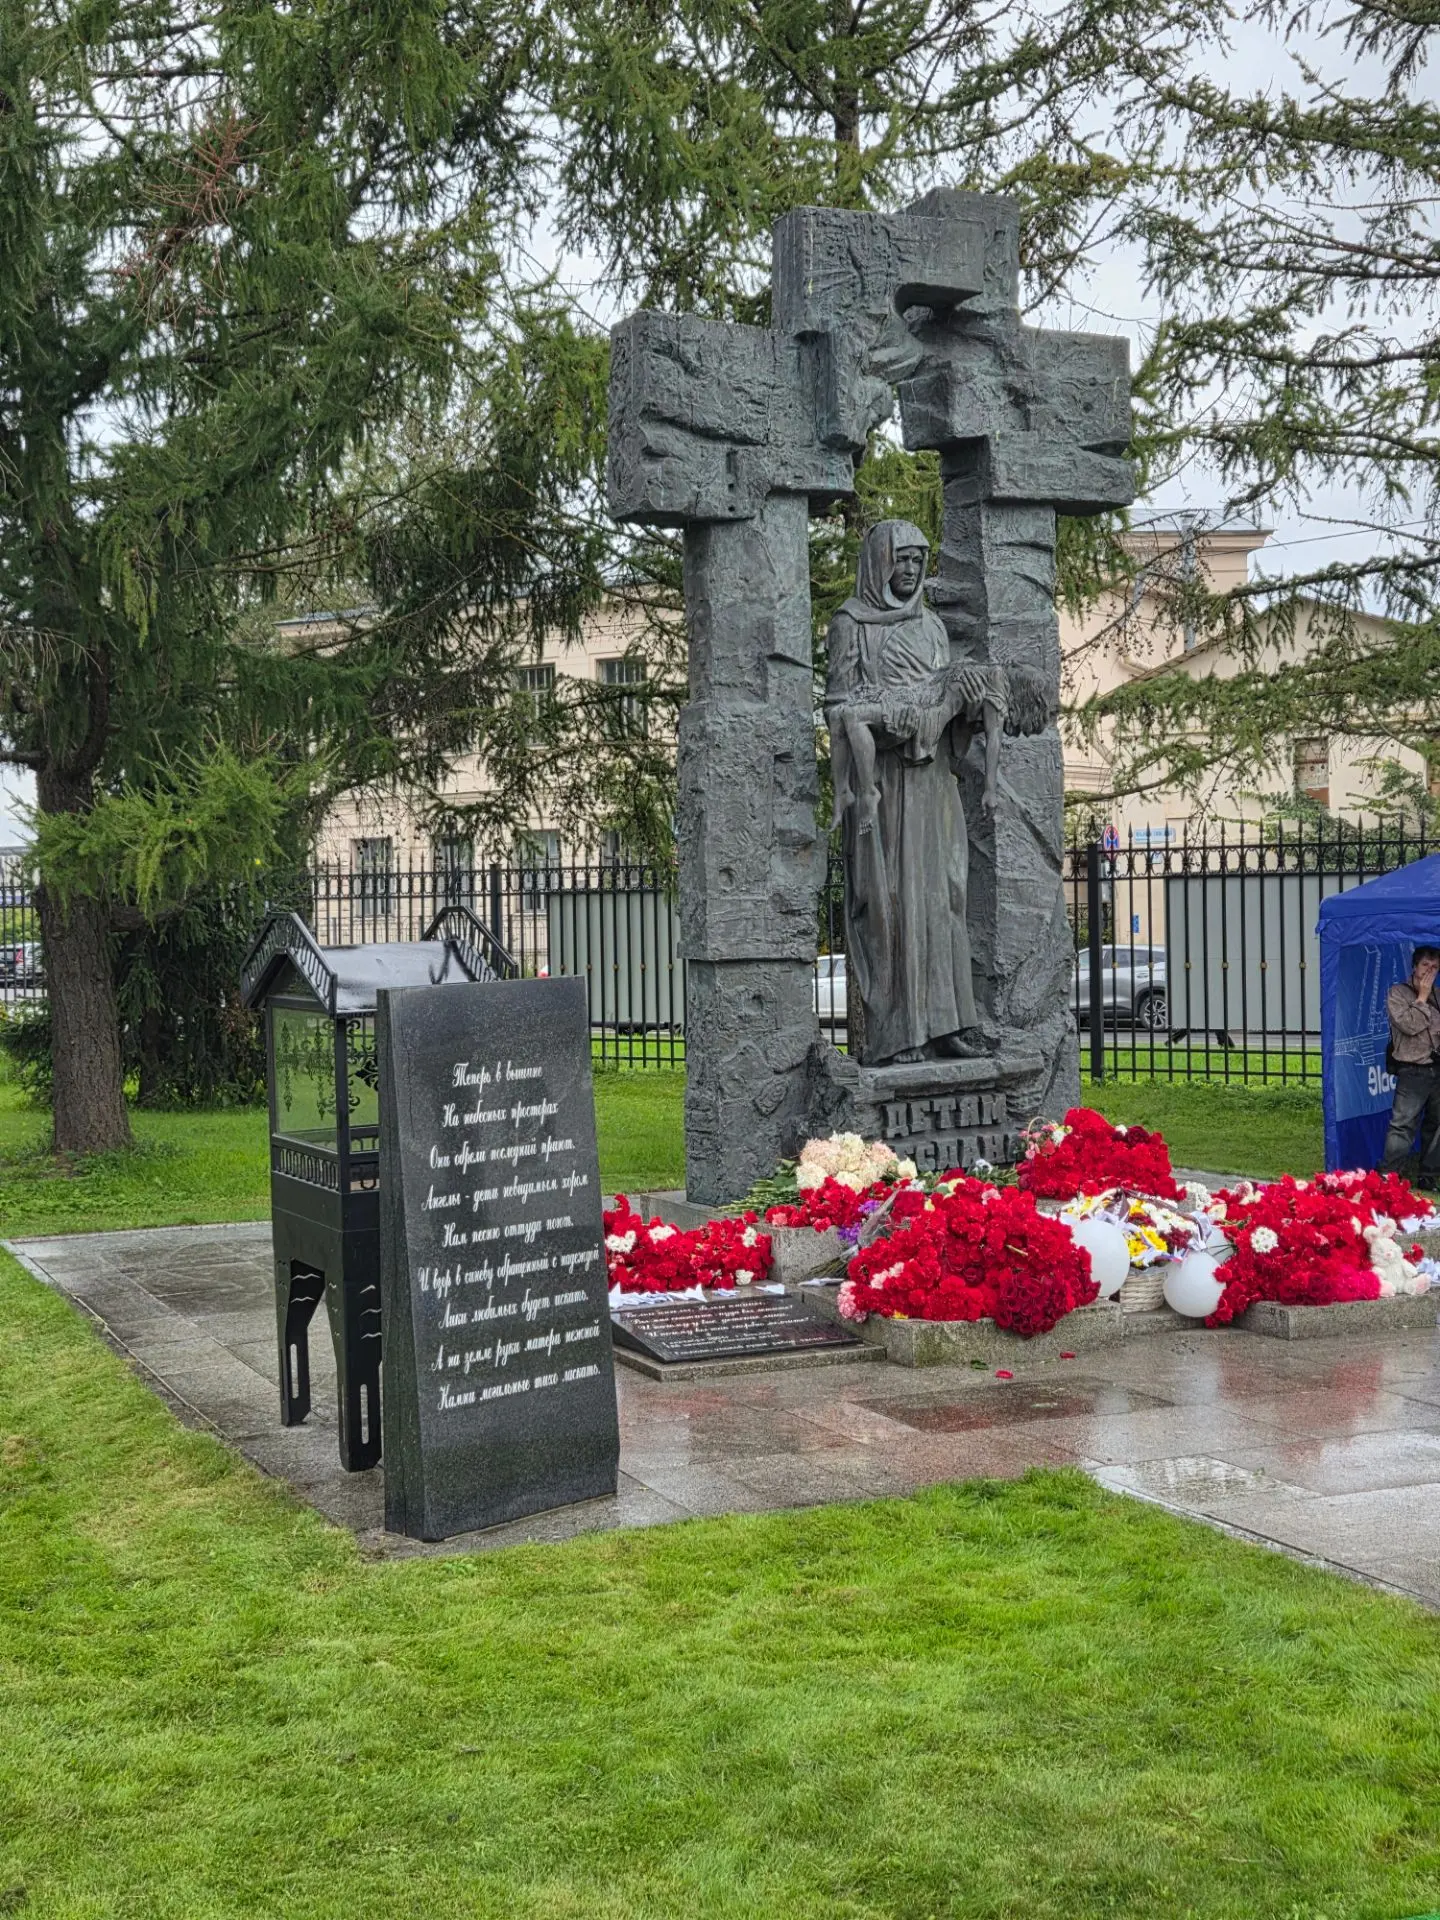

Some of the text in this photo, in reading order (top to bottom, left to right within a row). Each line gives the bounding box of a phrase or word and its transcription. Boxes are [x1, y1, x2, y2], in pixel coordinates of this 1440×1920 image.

[452, 1060, 543, 1094] Теперь в вышине
[442, 1098, 559, 1128] На небесных просторах
[886, 1092, 1007, 1139] ДЕТЯМ
[430, 1144, 451, 1169] Они
[454, 1140, 487, 1175] обрели
[490, 1137, 537, 1167] последний
[421, 1184, 462, 1212] Ангелы
[472, 1186, 499, 1212] дети
[503, 1175, 557, 1204] невидимым
[562, 1169, 589, 1197] хором
[442, 1222, 467, 1248] Нам
[472, 1227, 501, 1243] песню
[504, 1219, 542, 1244] оттуда
[417, 1267, 430, 1292] И
[433, 1267, 452, 1299] взор
[455, 1263, 462, 1286] в
[464, 1258, 494, 1290] синеву
[552, 1256, 558, 1268] с
[438, 1303, 468, 1329] Лики
[471, 1295, 518, 1322] любимых
[521, 1288, 550, 1322] будет
[431, 1319, 600, 1374] А на земле руки матери нежной
[437, 1383, 476, 1411] Камни
[479, 1378, 530, 1401] могильные
[534, 1372, 559, 1389] тихо
